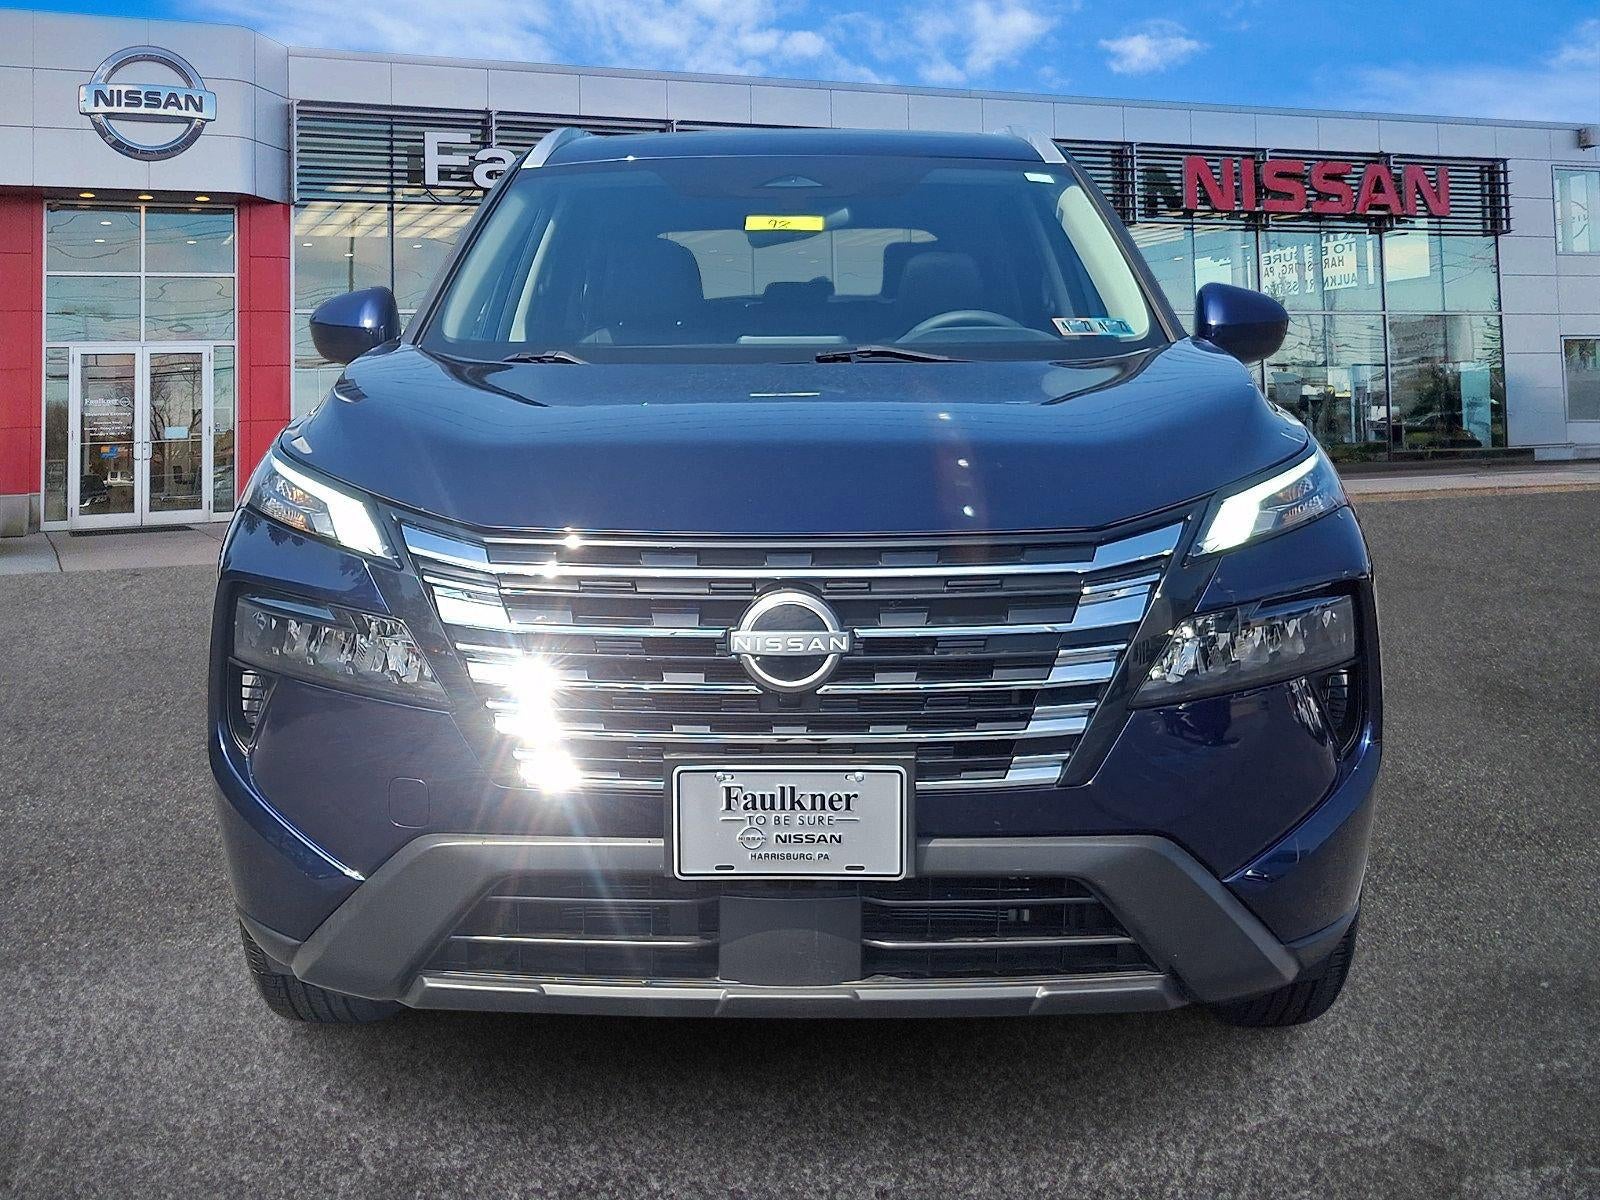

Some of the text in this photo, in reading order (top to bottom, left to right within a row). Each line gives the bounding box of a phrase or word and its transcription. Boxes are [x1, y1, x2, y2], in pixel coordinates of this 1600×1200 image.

[93, 89, 204, 113] NISSAN
[1182, 155, 1450, 216] NISSAN
[733, 636, 848, 652] NISSAN
[722, 785, 859, 811] Faulkner
[747, 815, 834, 826] TO BE SURE
[775, 834, 842, 844] NISSAN
[750, 852, 830, 861] HARRISBURG, PA
